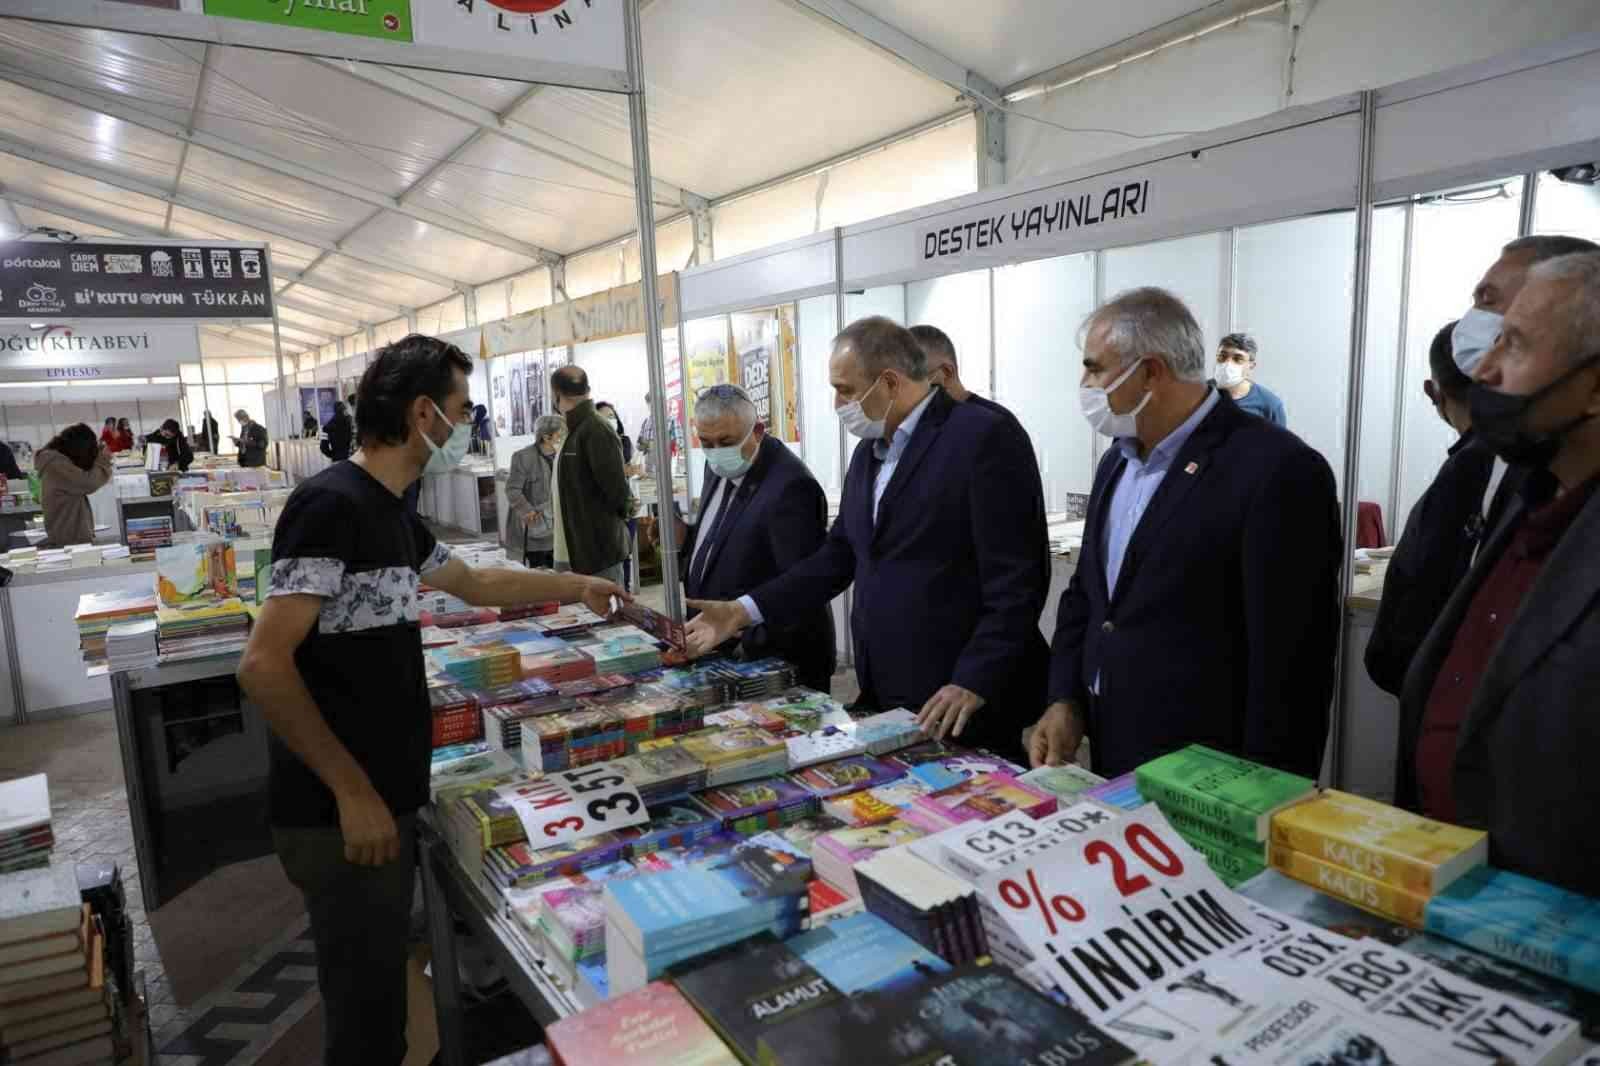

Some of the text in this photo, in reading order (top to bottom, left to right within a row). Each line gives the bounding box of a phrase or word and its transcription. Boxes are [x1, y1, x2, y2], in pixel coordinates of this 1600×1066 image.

[924, 180, 1150, 260] DESTEK YAYINLARI
[96, 292, 138, 304] KUTU
[51, 331, 149, 351] KİTABEVİ
[47, 367, 101, 377] EPHESUS
[1084, 822, 1184, 897] 20
[1046, 889, 1252, 1011] İNDİRİM
[1326, 949, 1411, 1002] ABC
[751, 978, 831, 1019] ALAMUT
[1383, 976, 1484, 1031] YAK
